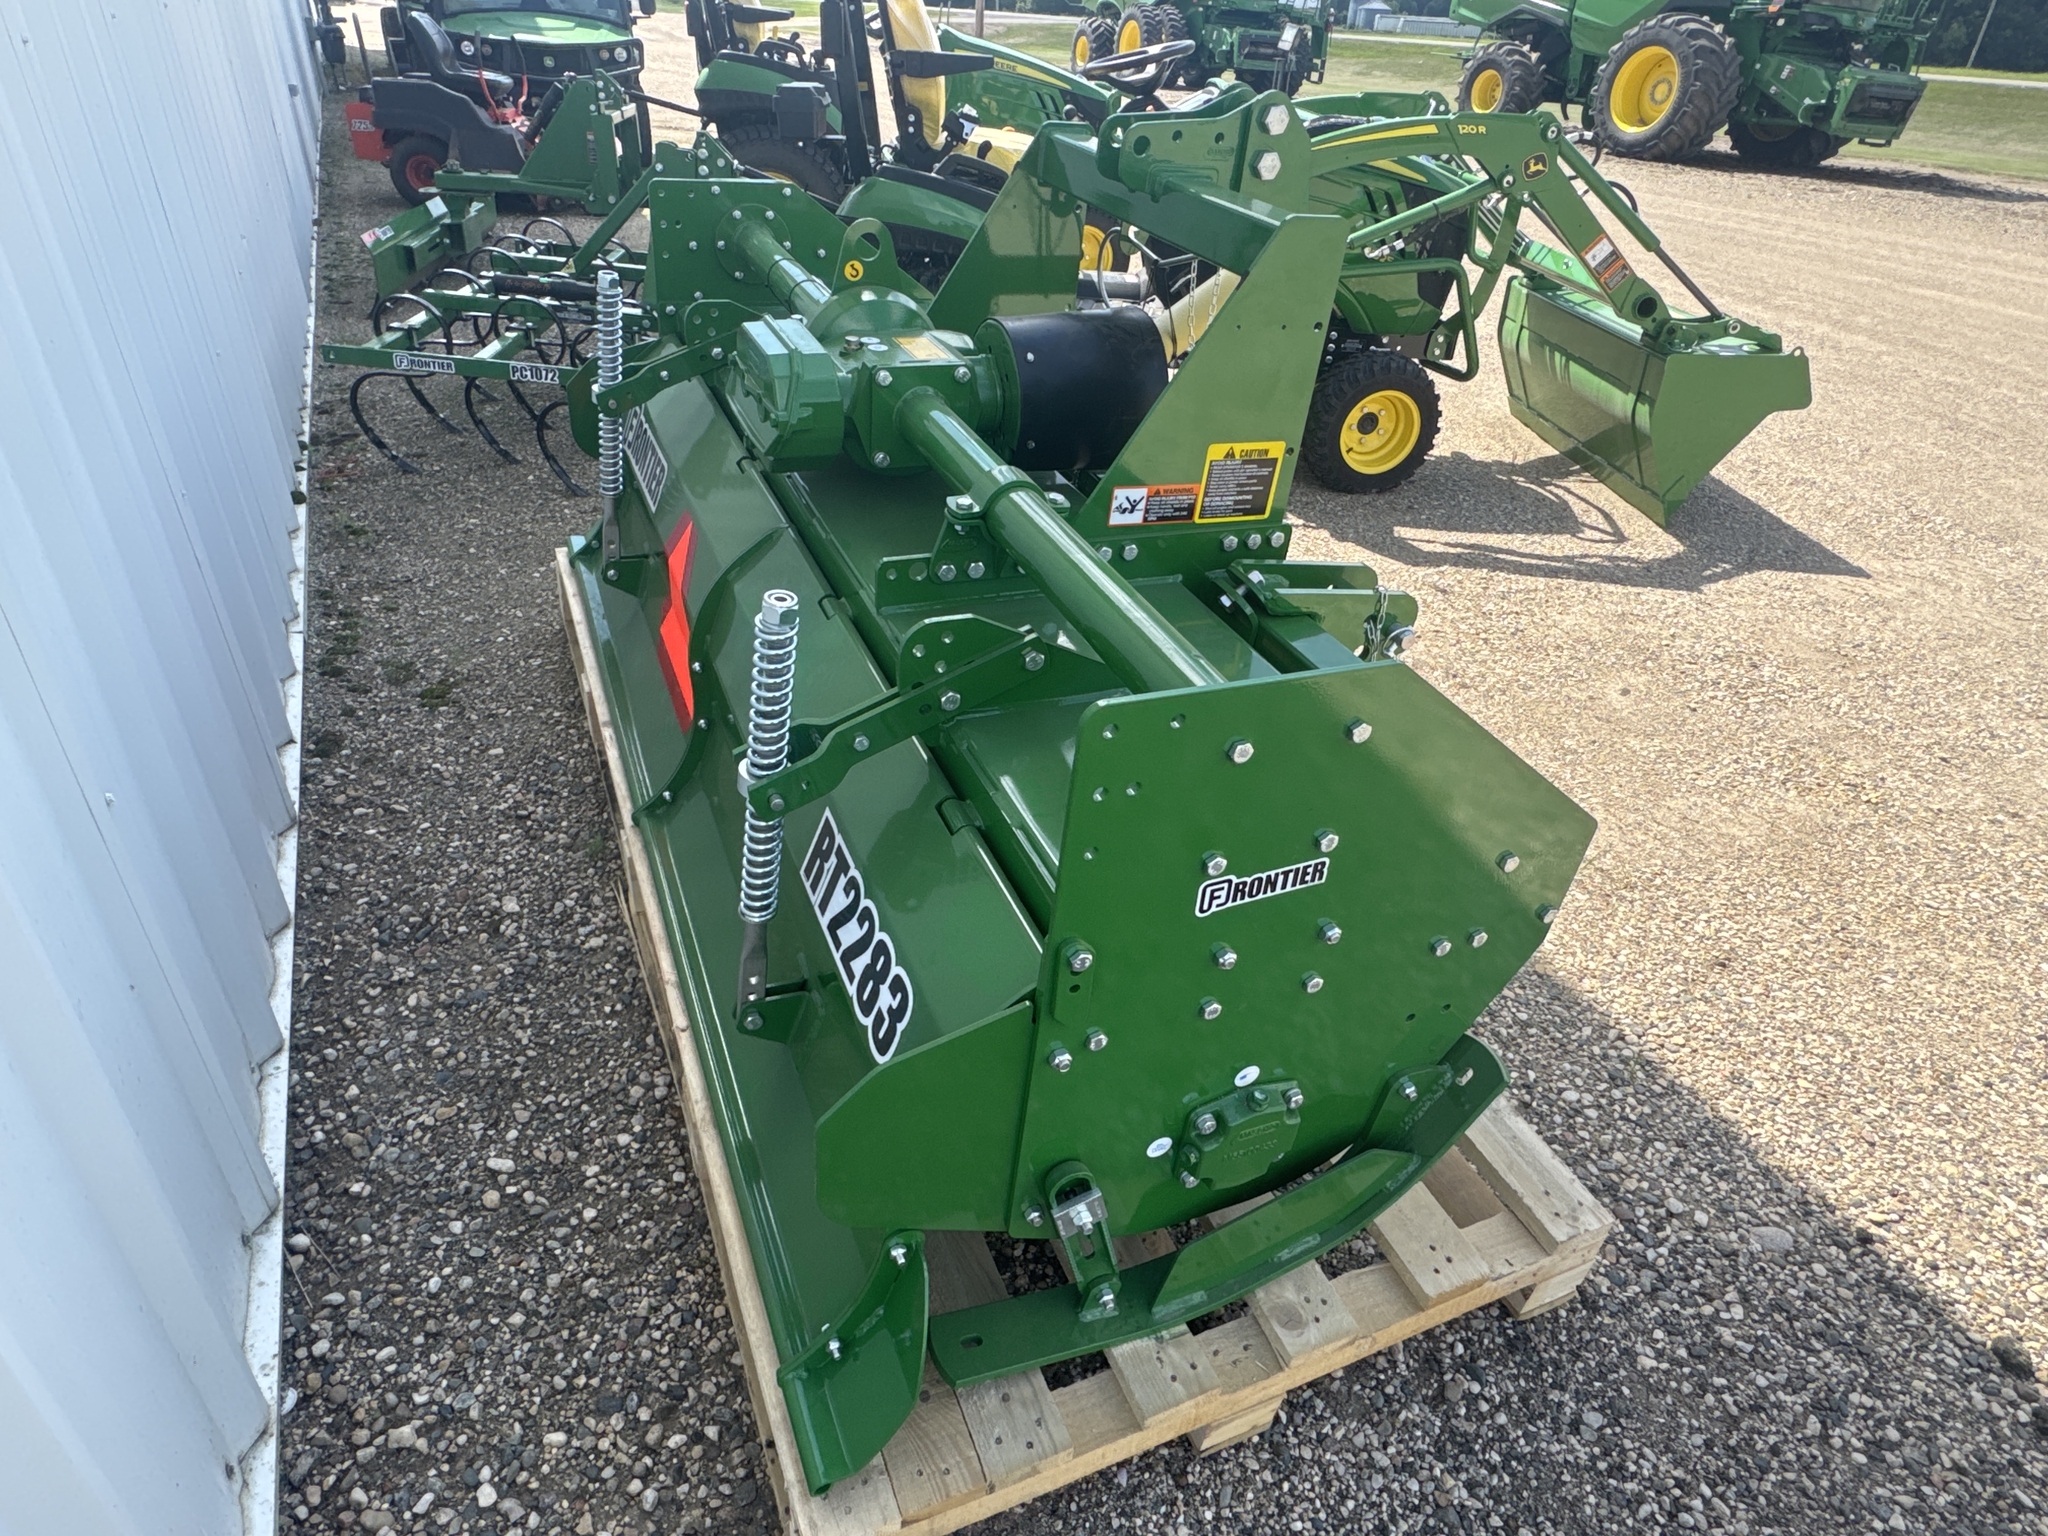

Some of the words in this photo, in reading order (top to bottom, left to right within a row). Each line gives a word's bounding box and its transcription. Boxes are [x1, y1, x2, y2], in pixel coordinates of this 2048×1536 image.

[995, 60, 1018, 72] EERE
[395, 355, 454, 371] FRONTIER
[511, 365, 559, 383] PC1072
[1239, 448, 1270, 459] CAUTION
[1163, 487, 1194, 495] WARNING
[1199, 860, 1328, 914] FRONTIER
[803, 815, 910, 1057] RT2283
